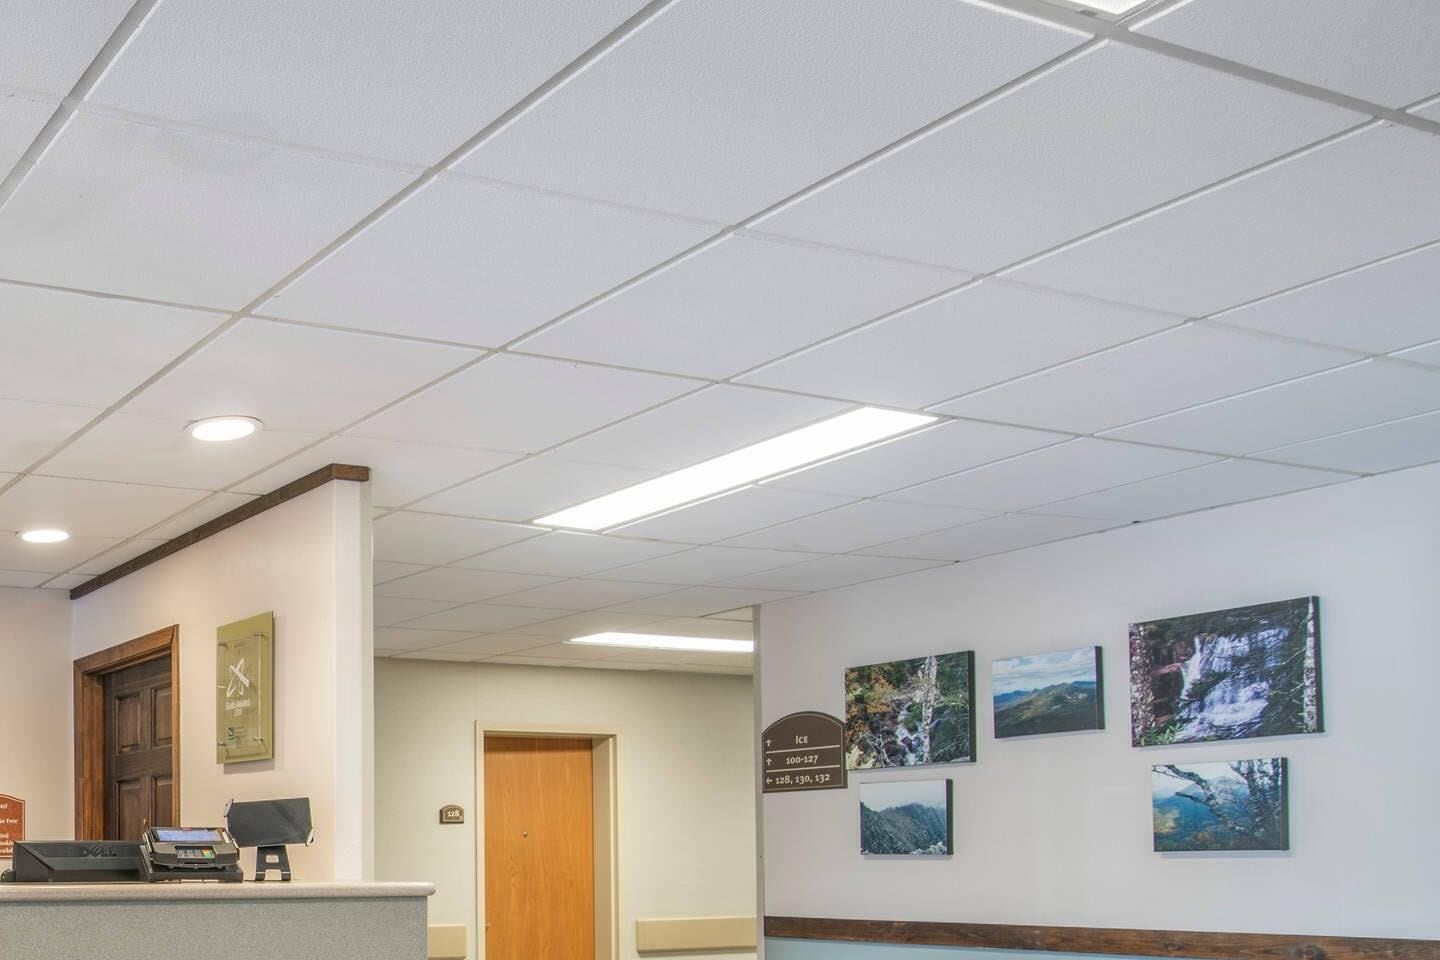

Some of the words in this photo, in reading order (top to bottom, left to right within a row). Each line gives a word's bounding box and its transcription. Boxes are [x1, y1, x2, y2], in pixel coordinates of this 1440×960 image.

[795, 735, 809, 745] ICE
[786, 755, 819, 765] 100-127
[775, 775, 793, 785] 128,
[795, 775, 813, 785] 130,
[815, 774, 831, 784] 132
